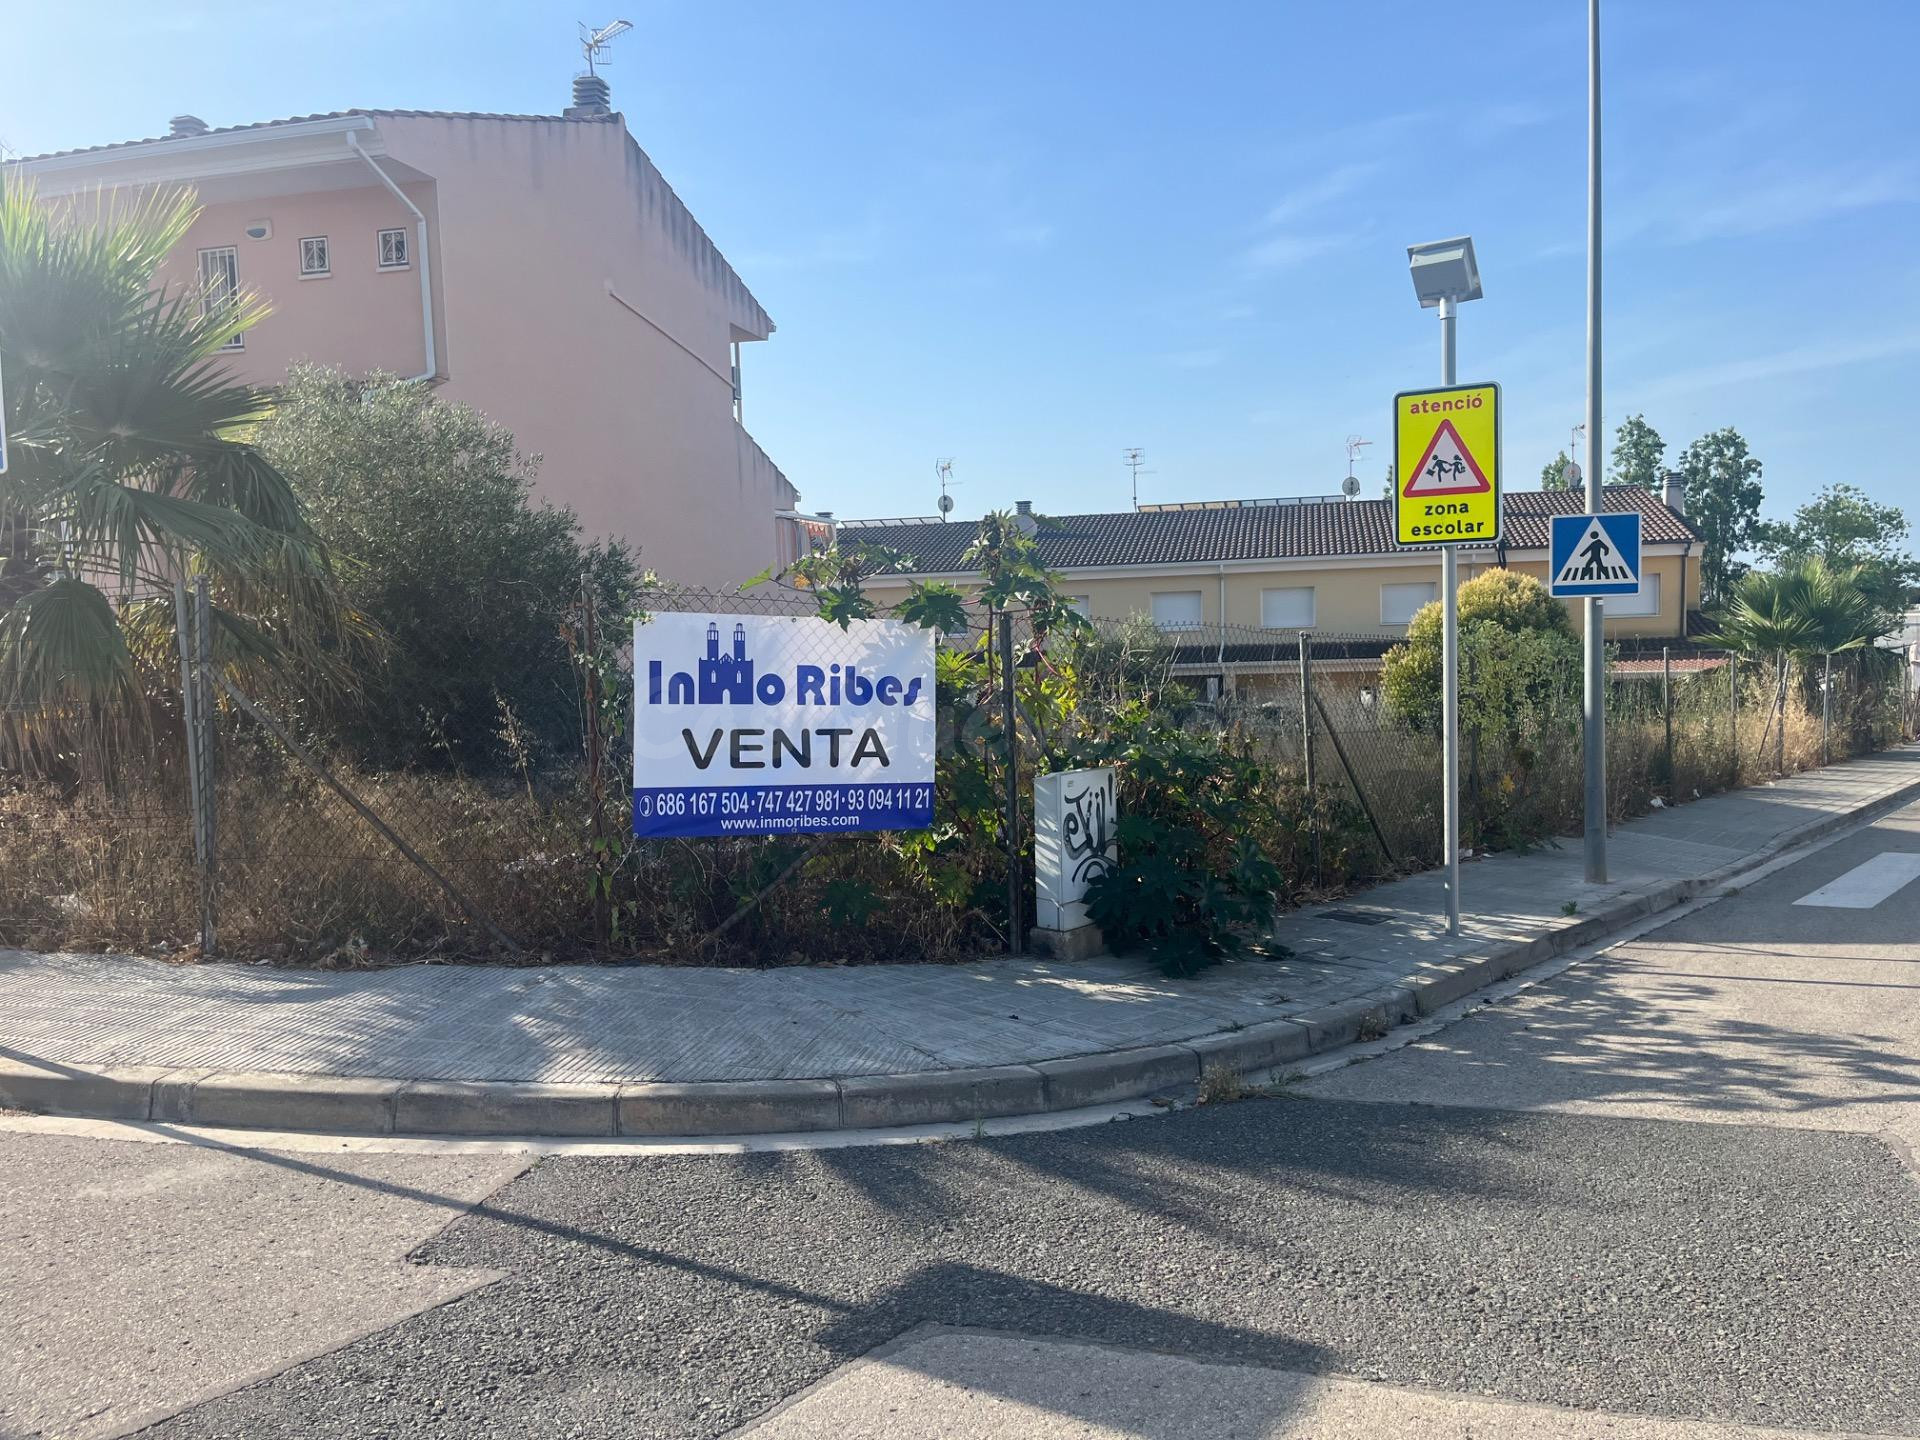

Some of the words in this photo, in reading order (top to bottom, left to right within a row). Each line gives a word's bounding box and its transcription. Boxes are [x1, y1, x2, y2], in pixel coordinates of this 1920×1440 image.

[1410, 393, 1483, 414] atenció
[1424, 503, 1469, 516] zona
[1411, 520, 1484, 536] escolar
[796, 663, 922, 707] Ribes
[681, 727, 891, 770] VENTA
[656, 793, 686, 816] 686
[690, 792, 717, 815] 167
[786, 790, 813, 812] 427
[867, 789, 893, 810] 094
[896, 788, 911, 809] 11
[914, 787, 930, 809] 21
[720, 815, 860, 830] www.inmoribes.com
